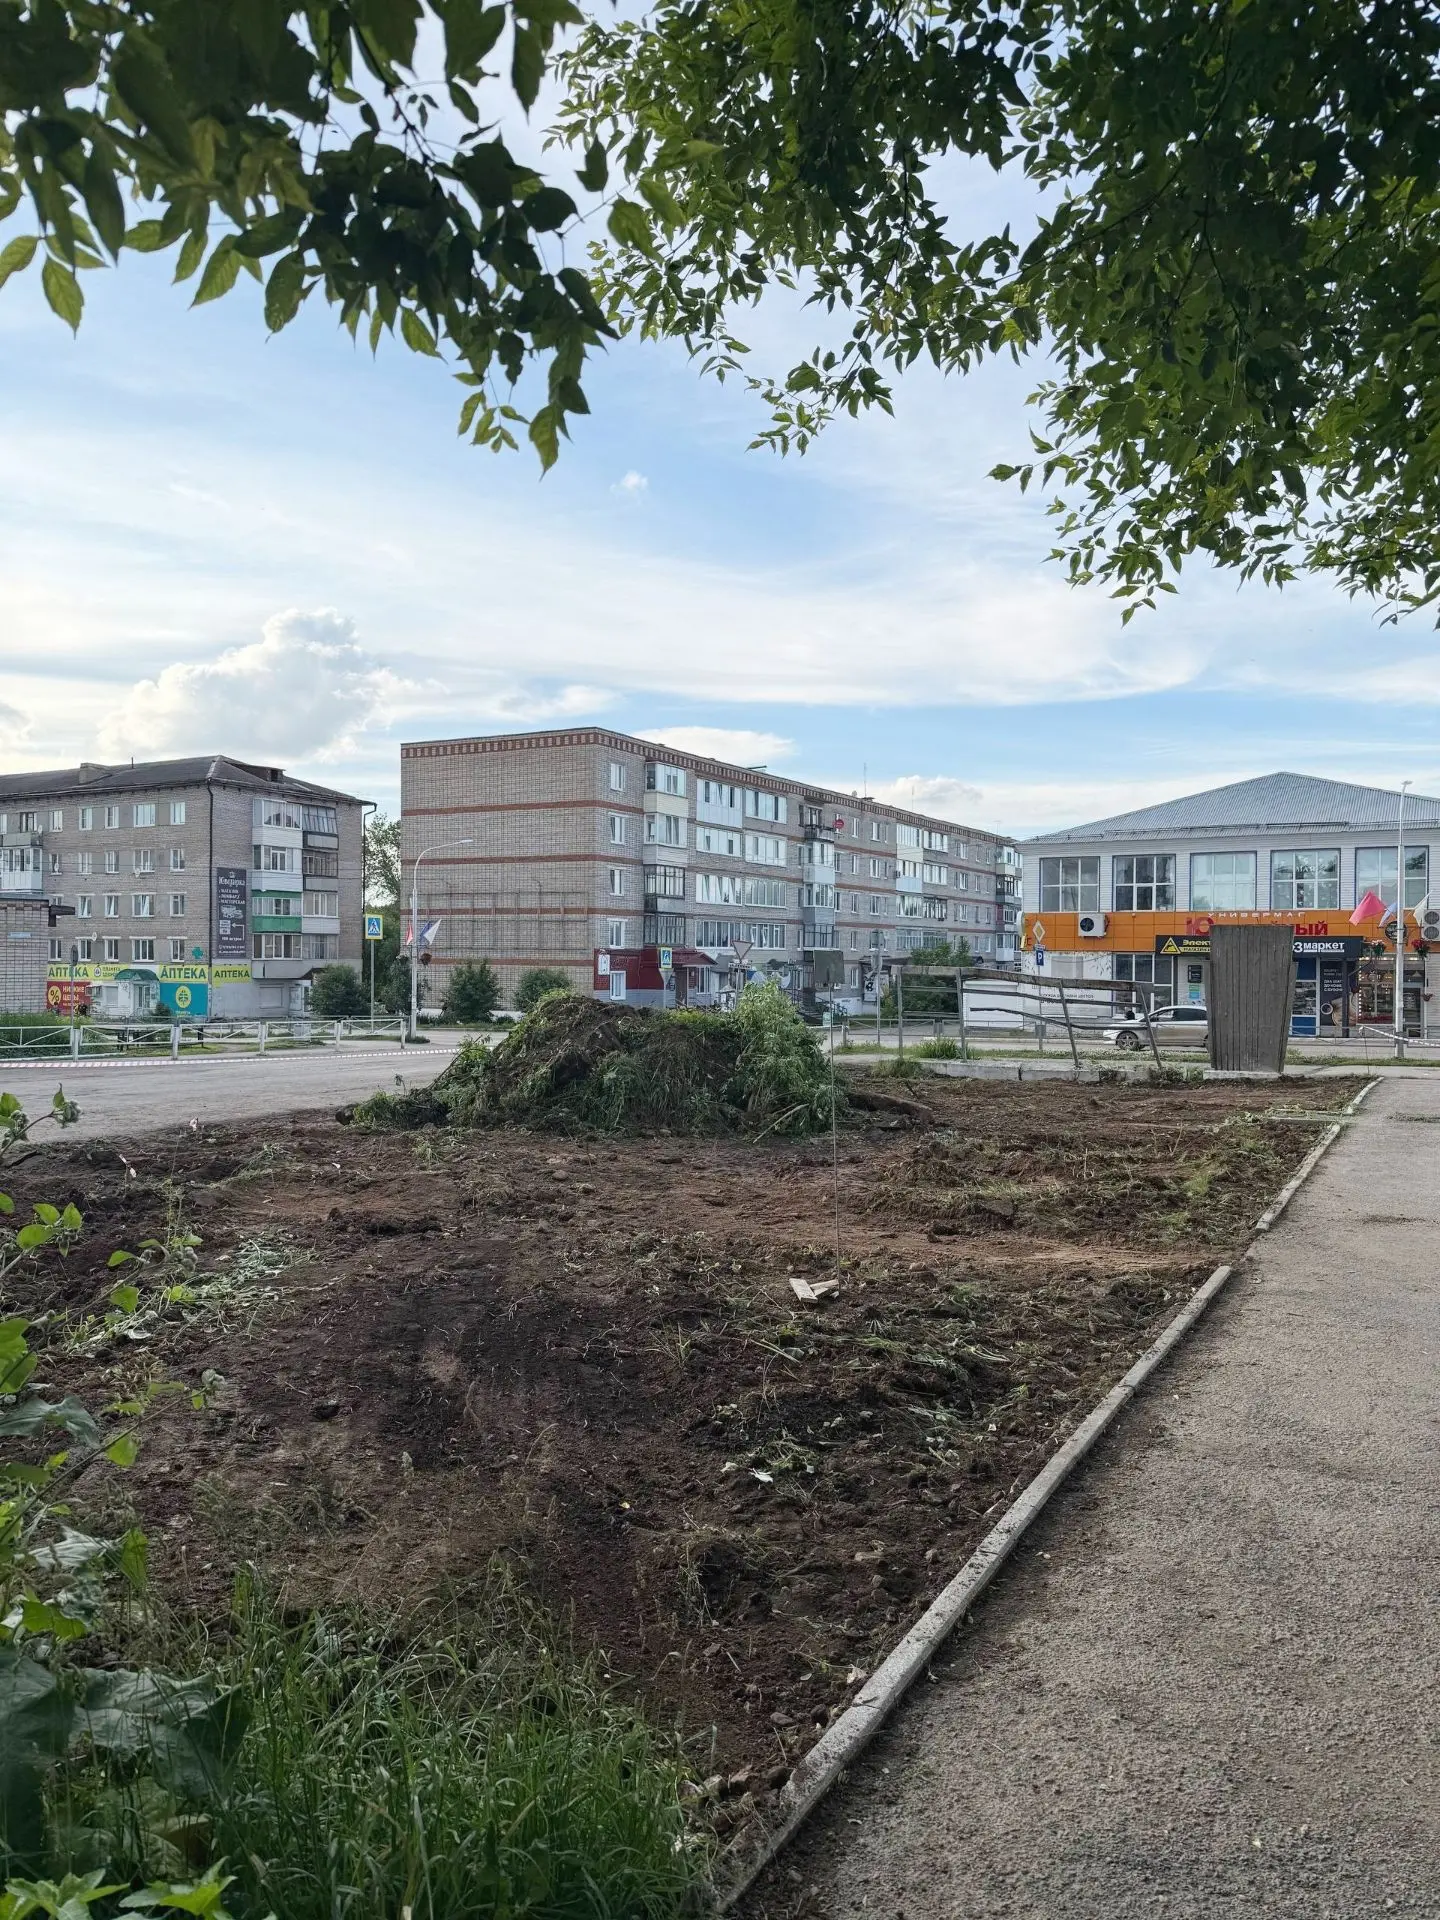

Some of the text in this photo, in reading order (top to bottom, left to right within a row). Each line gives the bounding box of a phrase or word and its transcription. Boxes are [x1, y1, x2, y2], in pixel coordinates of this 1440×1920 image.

[160, 967, 207, 979] АПТЕКА
[214, 970, 250, 978] АПТЕКА
[62, 985, 85, 993] НИКИЕ
